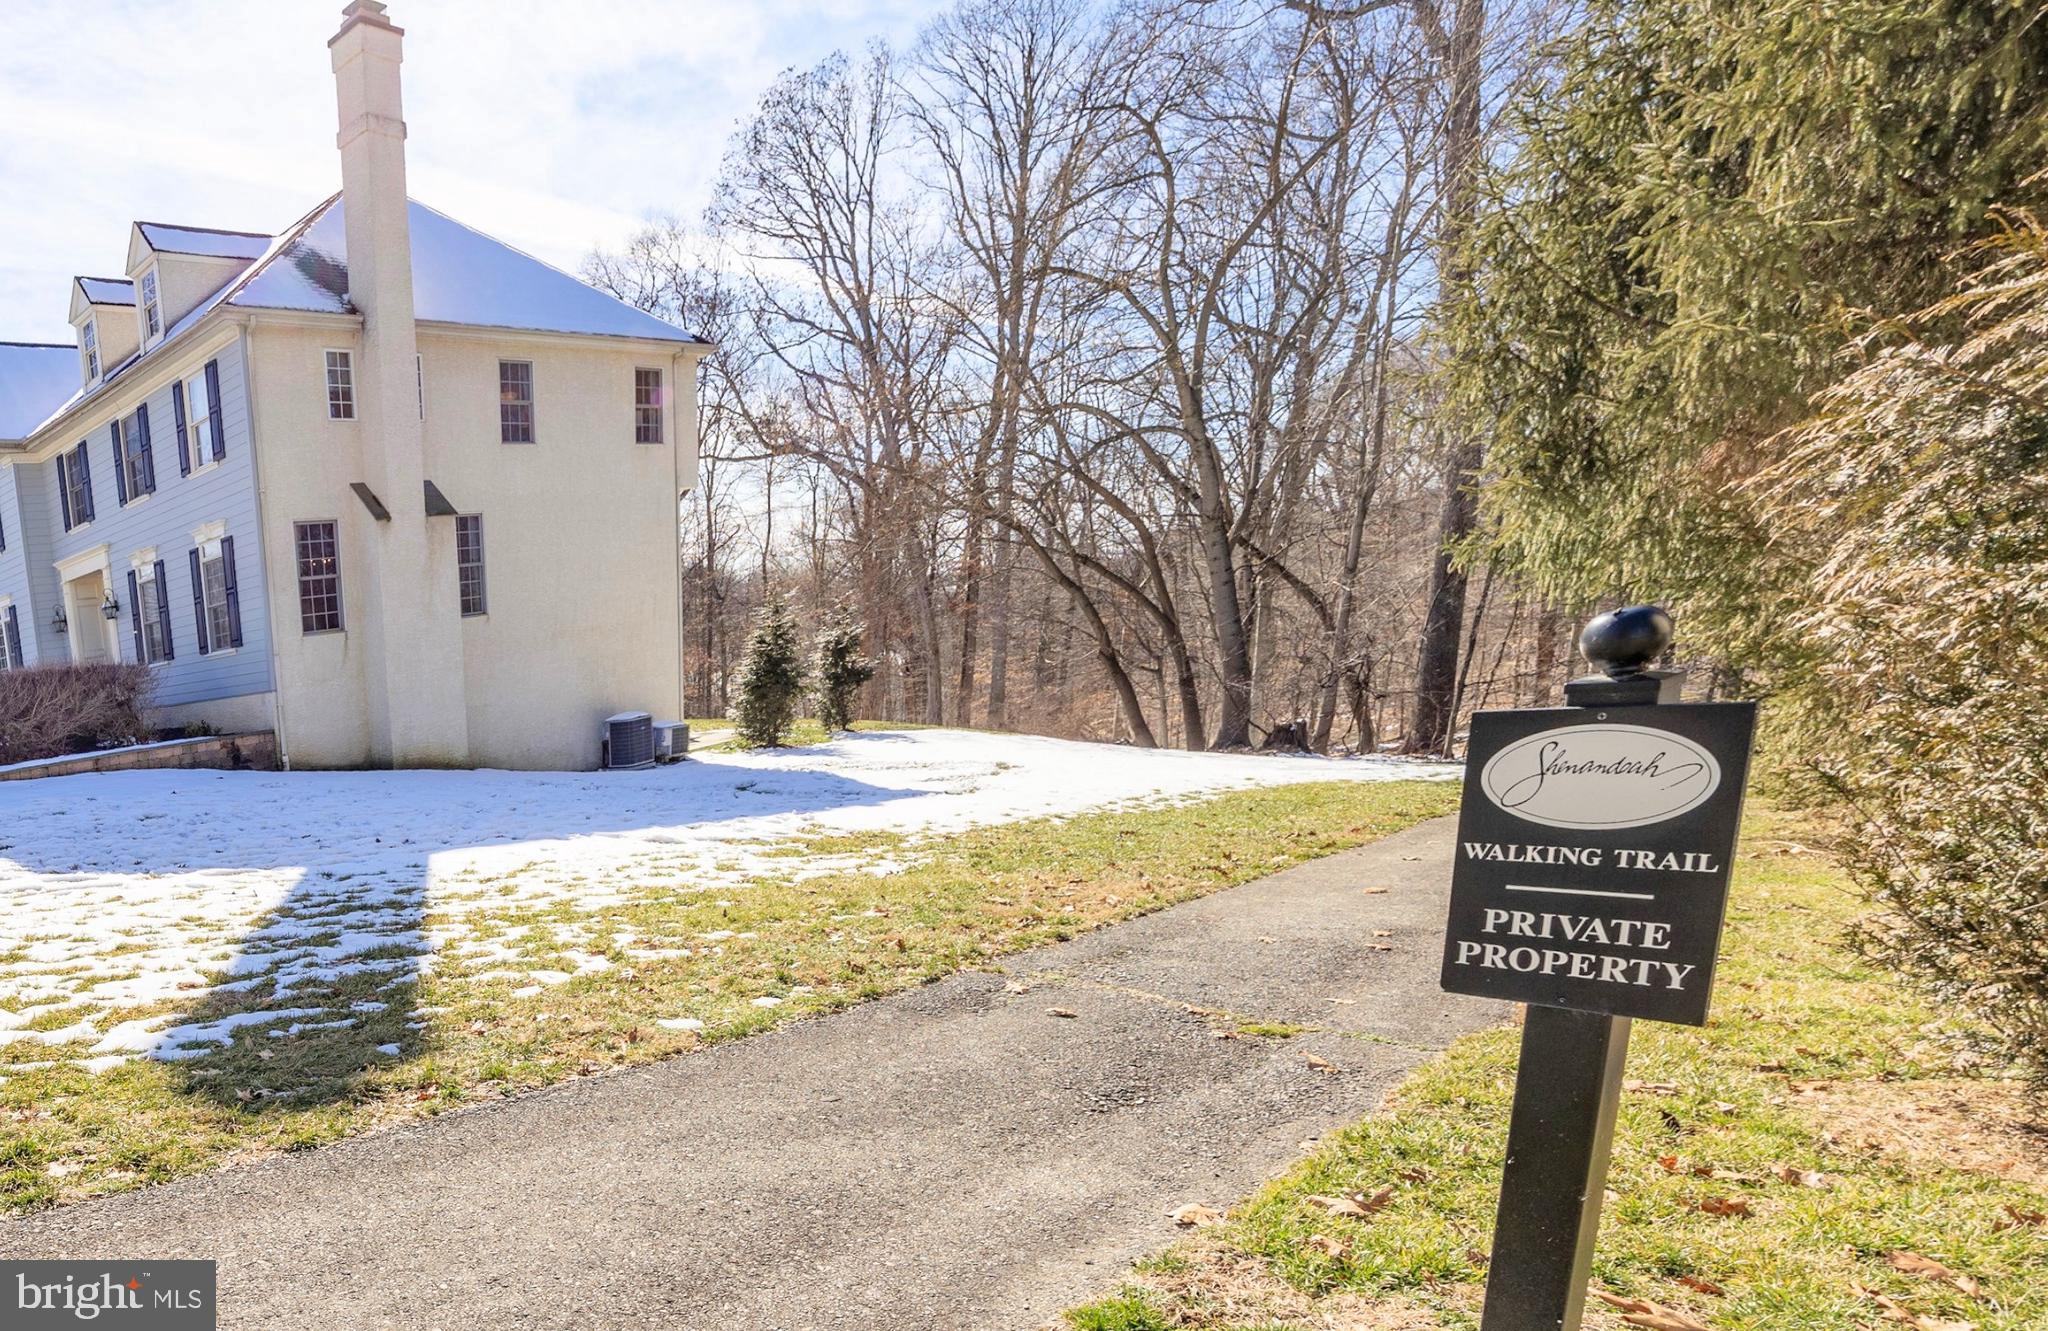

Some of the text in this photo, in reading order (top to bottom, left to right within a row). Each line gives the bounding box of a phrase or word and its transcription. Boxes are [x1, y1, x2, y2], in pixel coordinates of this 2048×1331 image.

[1501, 741, 1703, 807] Shenandoah
[1463, 841, 1719, 873] WALKING TRAIL
[1480, 907, 1672, 950] PRIVATE
[1454, 940, 1696, 991] PROPERTY
